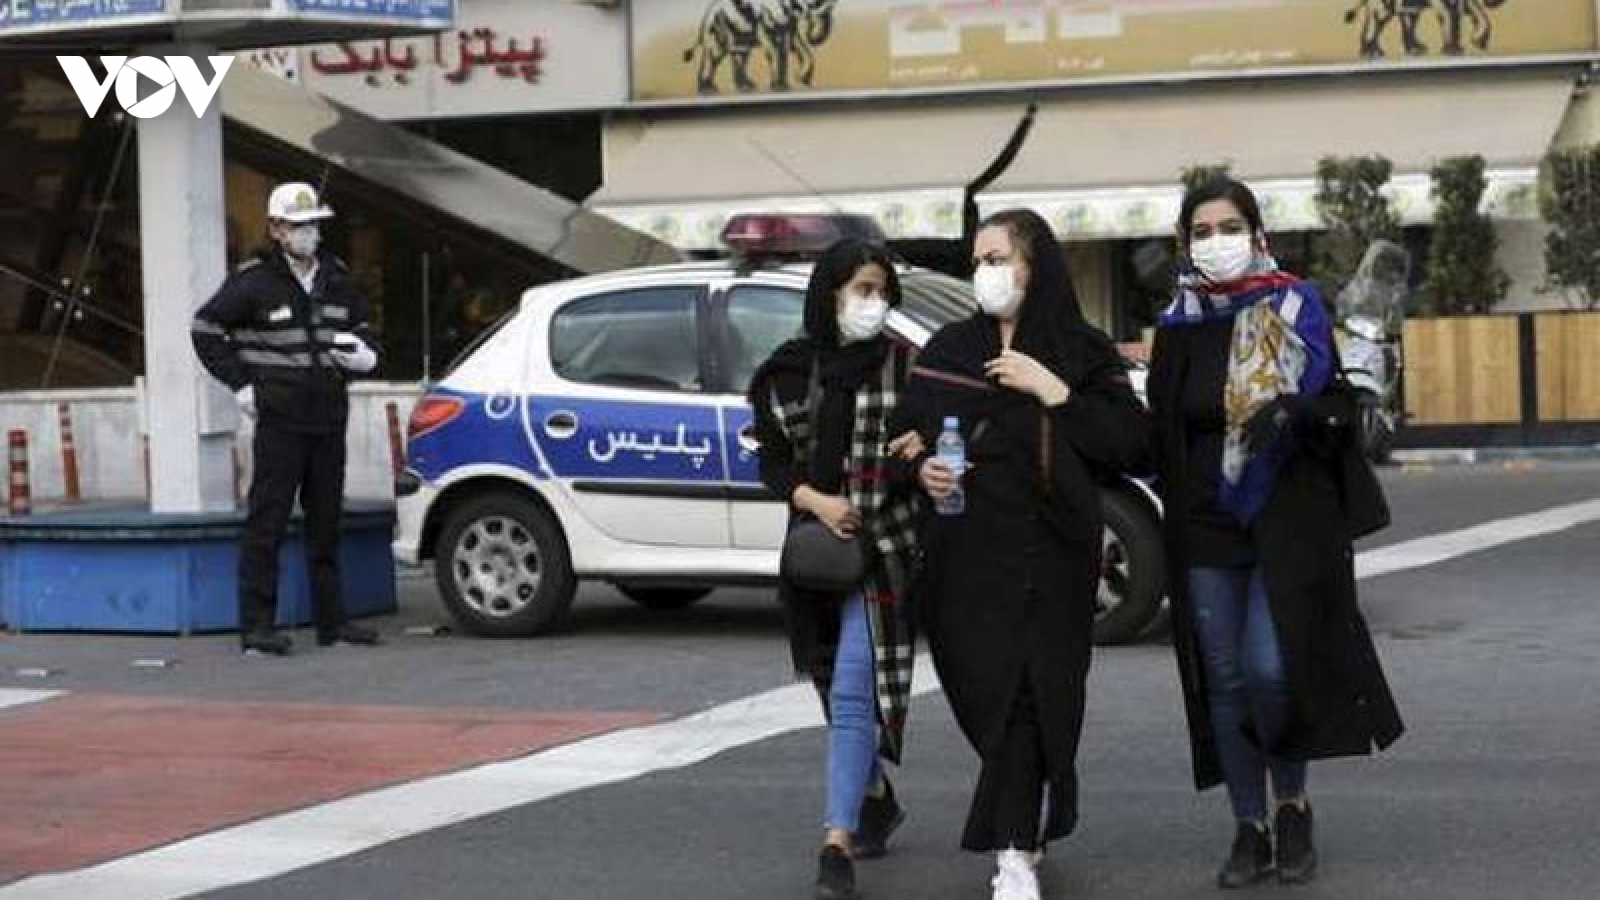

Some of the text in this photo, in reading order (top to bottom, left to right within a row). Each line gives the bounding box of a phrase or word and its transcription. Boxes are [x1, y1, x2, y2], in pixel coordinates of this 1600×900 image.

[310, 27, 545, 86] پیتزا بابک
[588, 423, 711, 470] پلیس
